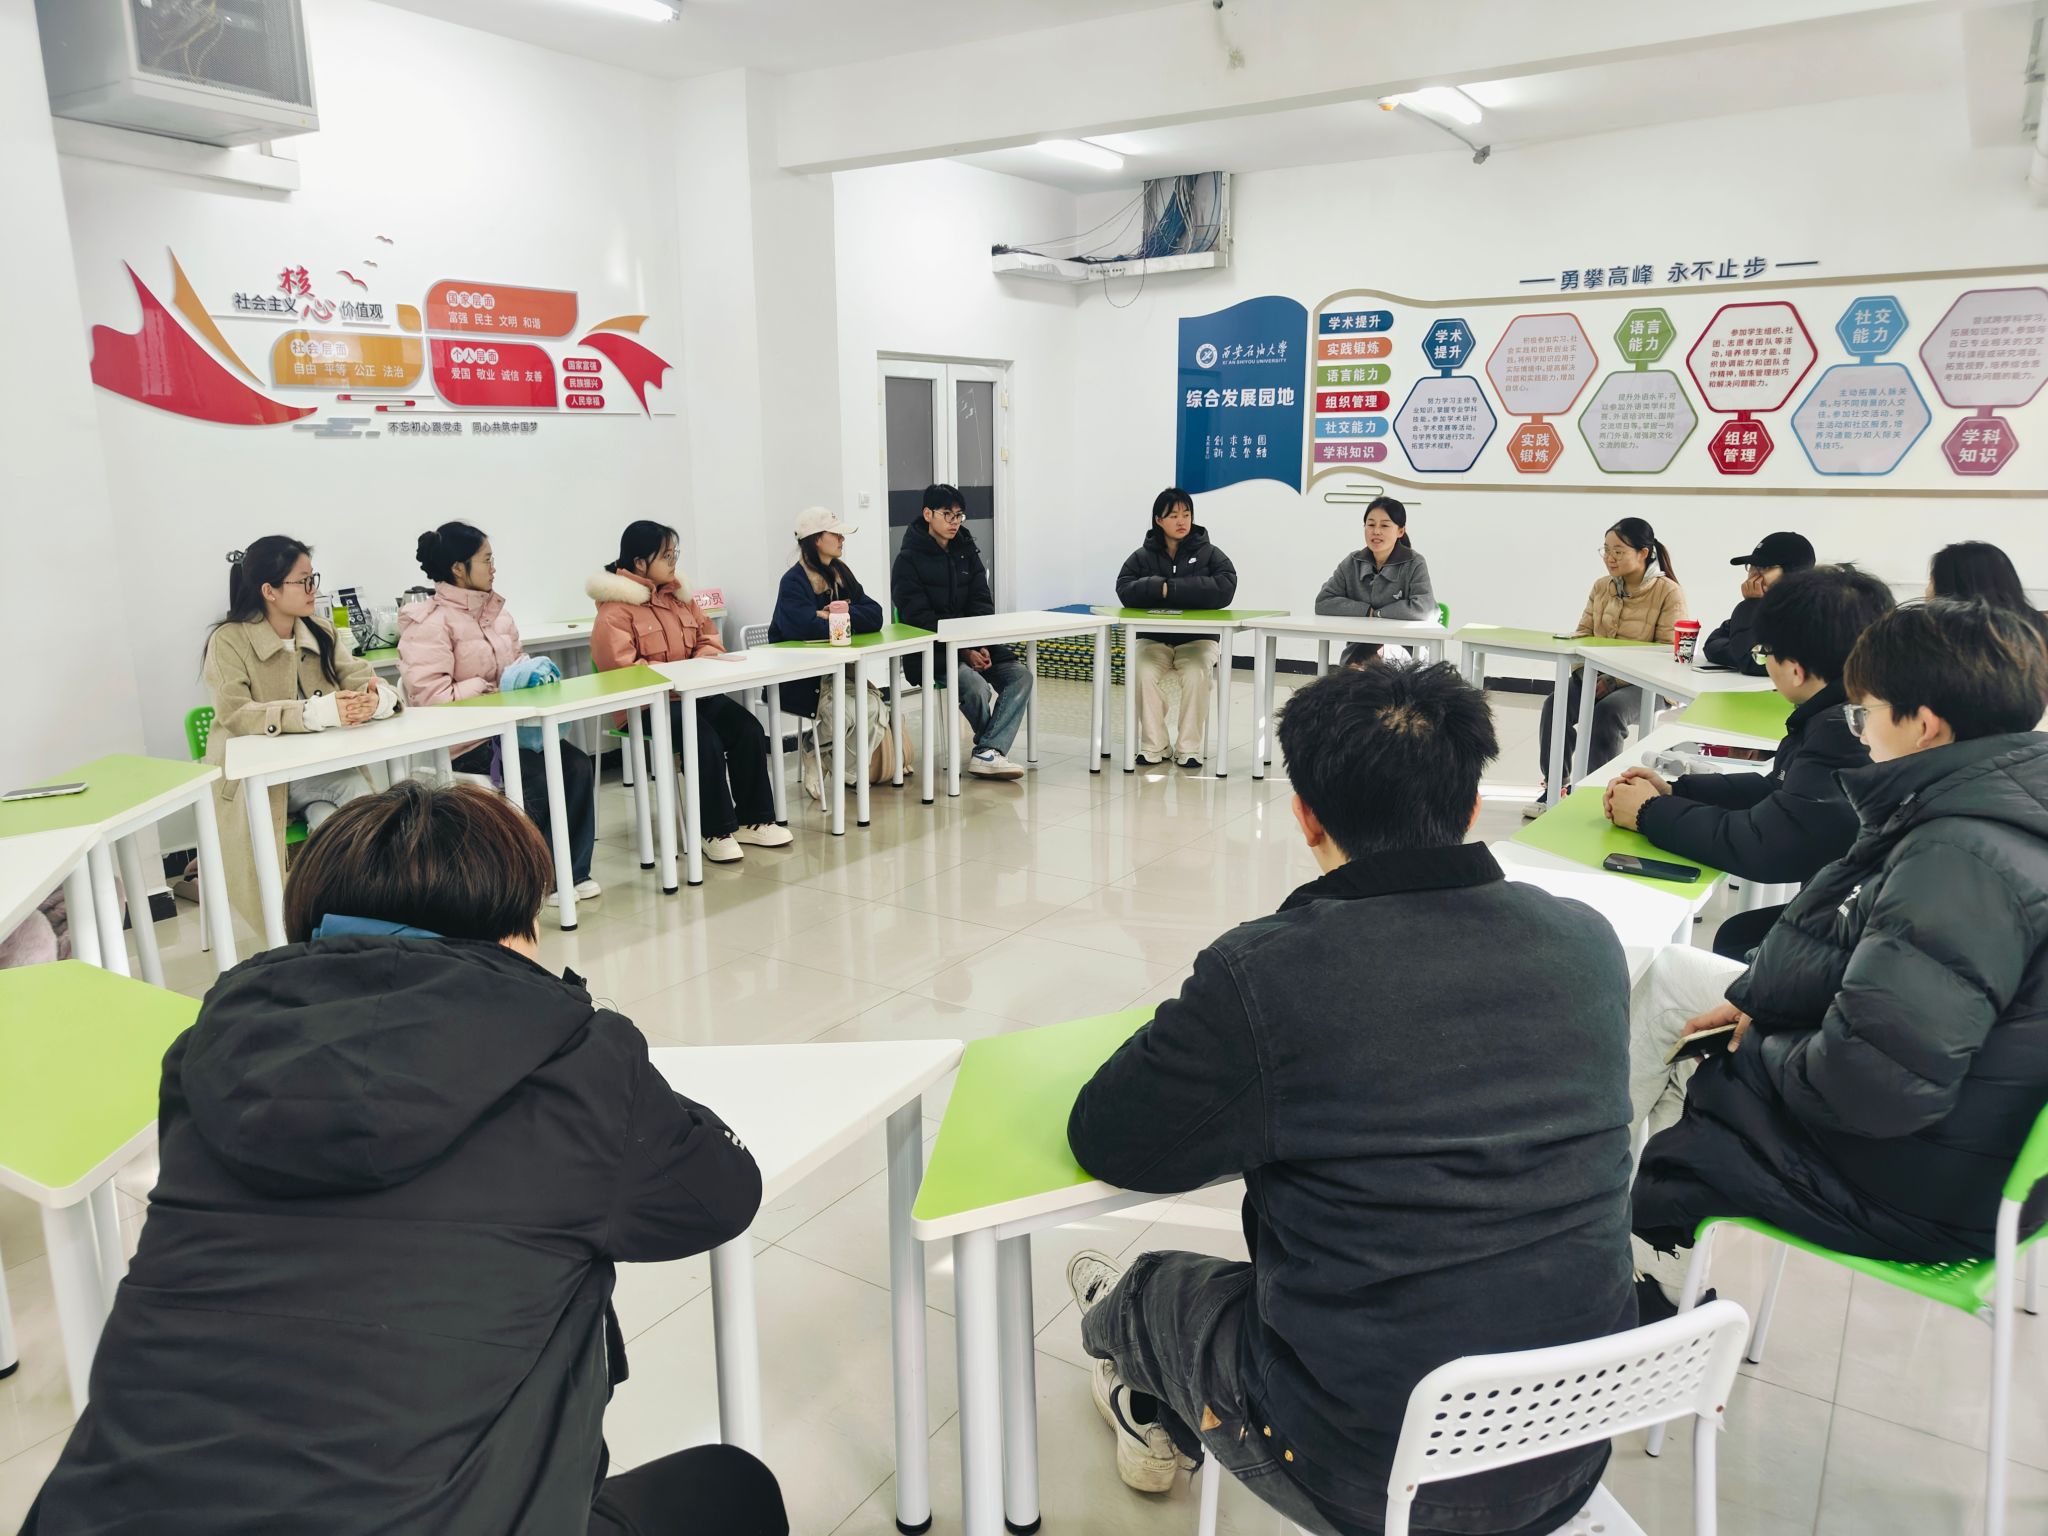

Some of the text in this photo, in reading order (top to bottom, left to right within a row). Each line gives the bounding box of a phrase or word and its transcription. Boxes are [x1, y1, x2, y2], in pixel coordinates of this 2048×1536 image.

[1560, 257, 1768, 290] 勇攀高峰 永不止步
[234, 292, 298, 313] 社会主义
[341, 301, 384, 320] 价值观
[447, 291, 494, 309] 国家层面
[448, 311, 541, 329] 富强 民主 文明 和谐
[1328, 315, 1381, 330] 学术提升
[1854, 309, 1893, 325] 社交
[1630, 320, 1662, 335] 语言
[1435, 329, 1462, 343] 学术
[1852, 327, 1889, 344] 能力
[292, 341, 348, 357] 社会层面
[1327, 341, 1380, 356] 实践锻炼
[1434, 345, 1462, 359] 提升
[1628, 337, 1659, 352] 能力
[452, 348, 498, 364] 个人层面
[294, 363, 404, 378] 自由 平等 公正 法治
[568, 360, 598, 371] 国家富强
[451, 367, 542, 383] 爱国 敬业 诚信 友善
[1326, 367, 1378, 383] 语言能力
[569, 379, 599, 389] 民族振兴
[571, 396, 600, 407] 人民幸福
[1186, 387, 1295, 408] 综合发展园地
[1325, 394, 1378, 409] 组织管理
[389, 421, 538, 433] 不忘初心跟党走 同心共筑中国梦
[1325, 421, 1376, 435] 社交能力
[1521, 433, 1550, 447] 实践
[1725, 431, 1758, 446] 组织
[1961, 428, 2001, 445] 学科
[1323, 446, 1375, 460] 学科知识
[1519, 448, 1549, 463] 锻炼
[1723, 448, 1757, 463] 管理
[1958, 447, 1999, 464] 知识
